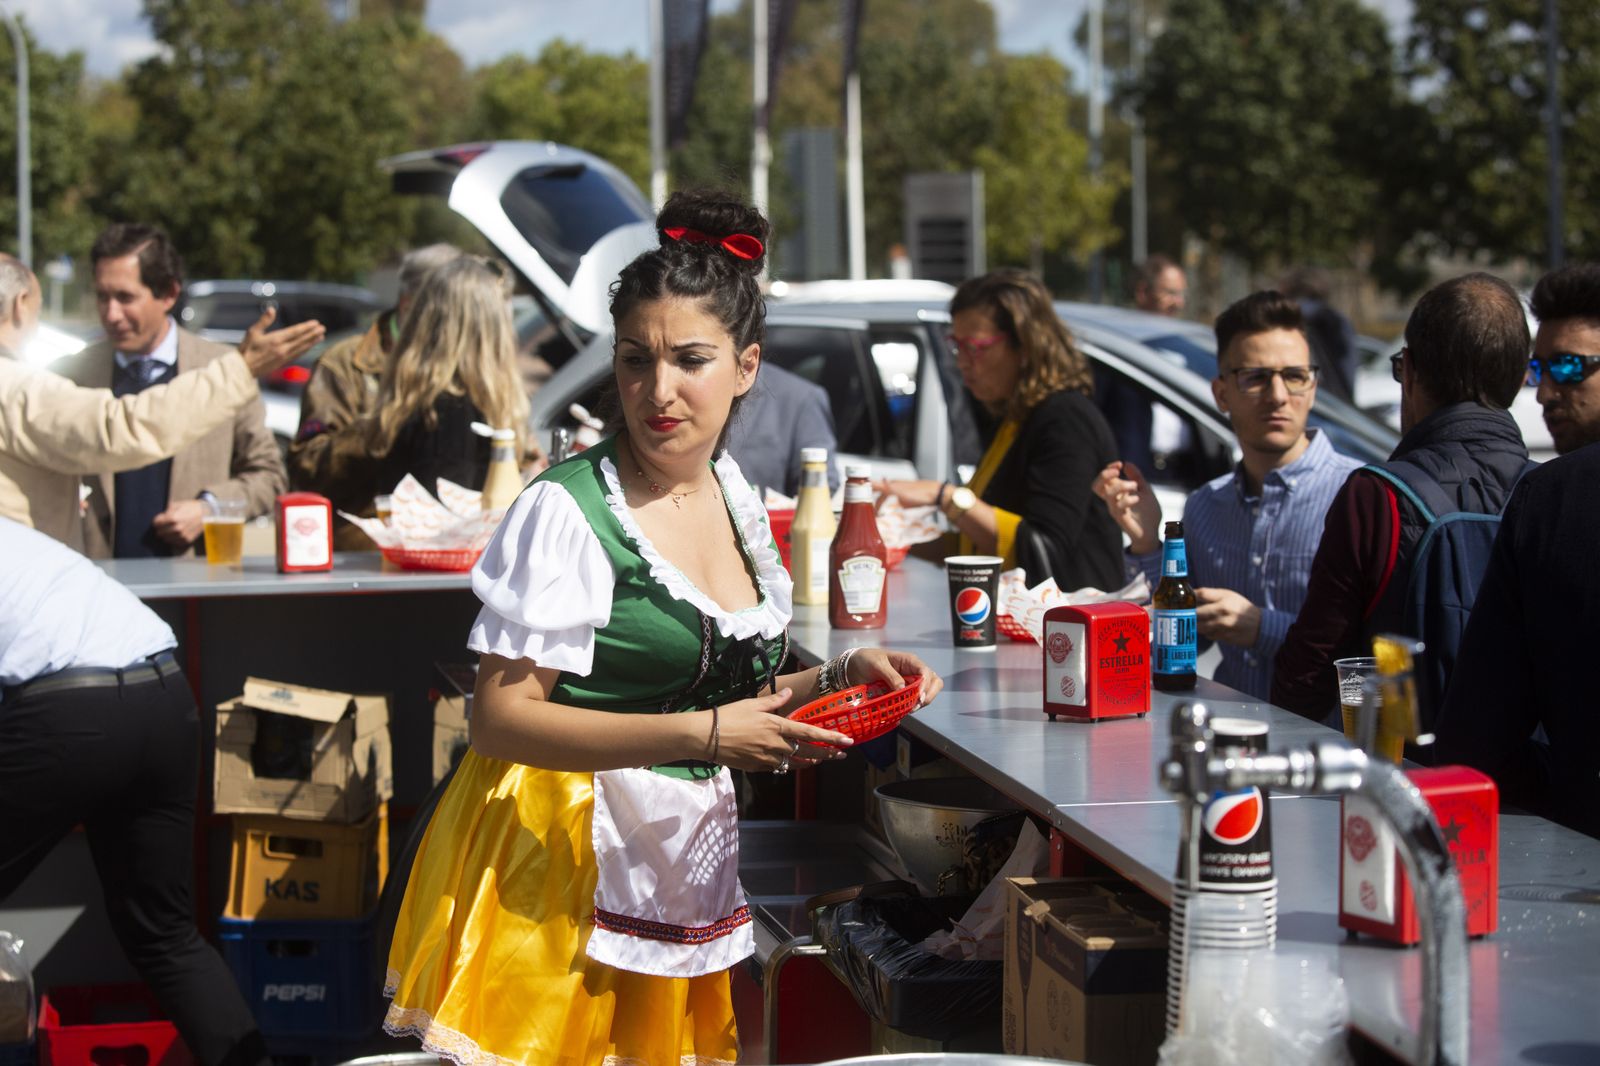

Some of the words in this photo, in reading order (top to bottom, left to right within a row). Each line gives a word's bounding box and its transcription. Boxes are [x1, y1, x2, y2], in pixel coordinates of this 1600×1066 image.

[1099, 653, 1144, 669] ESTRELLA
[264, 877, 321, 903] KAS
[262, 983, 327, 1003] PEPSI
